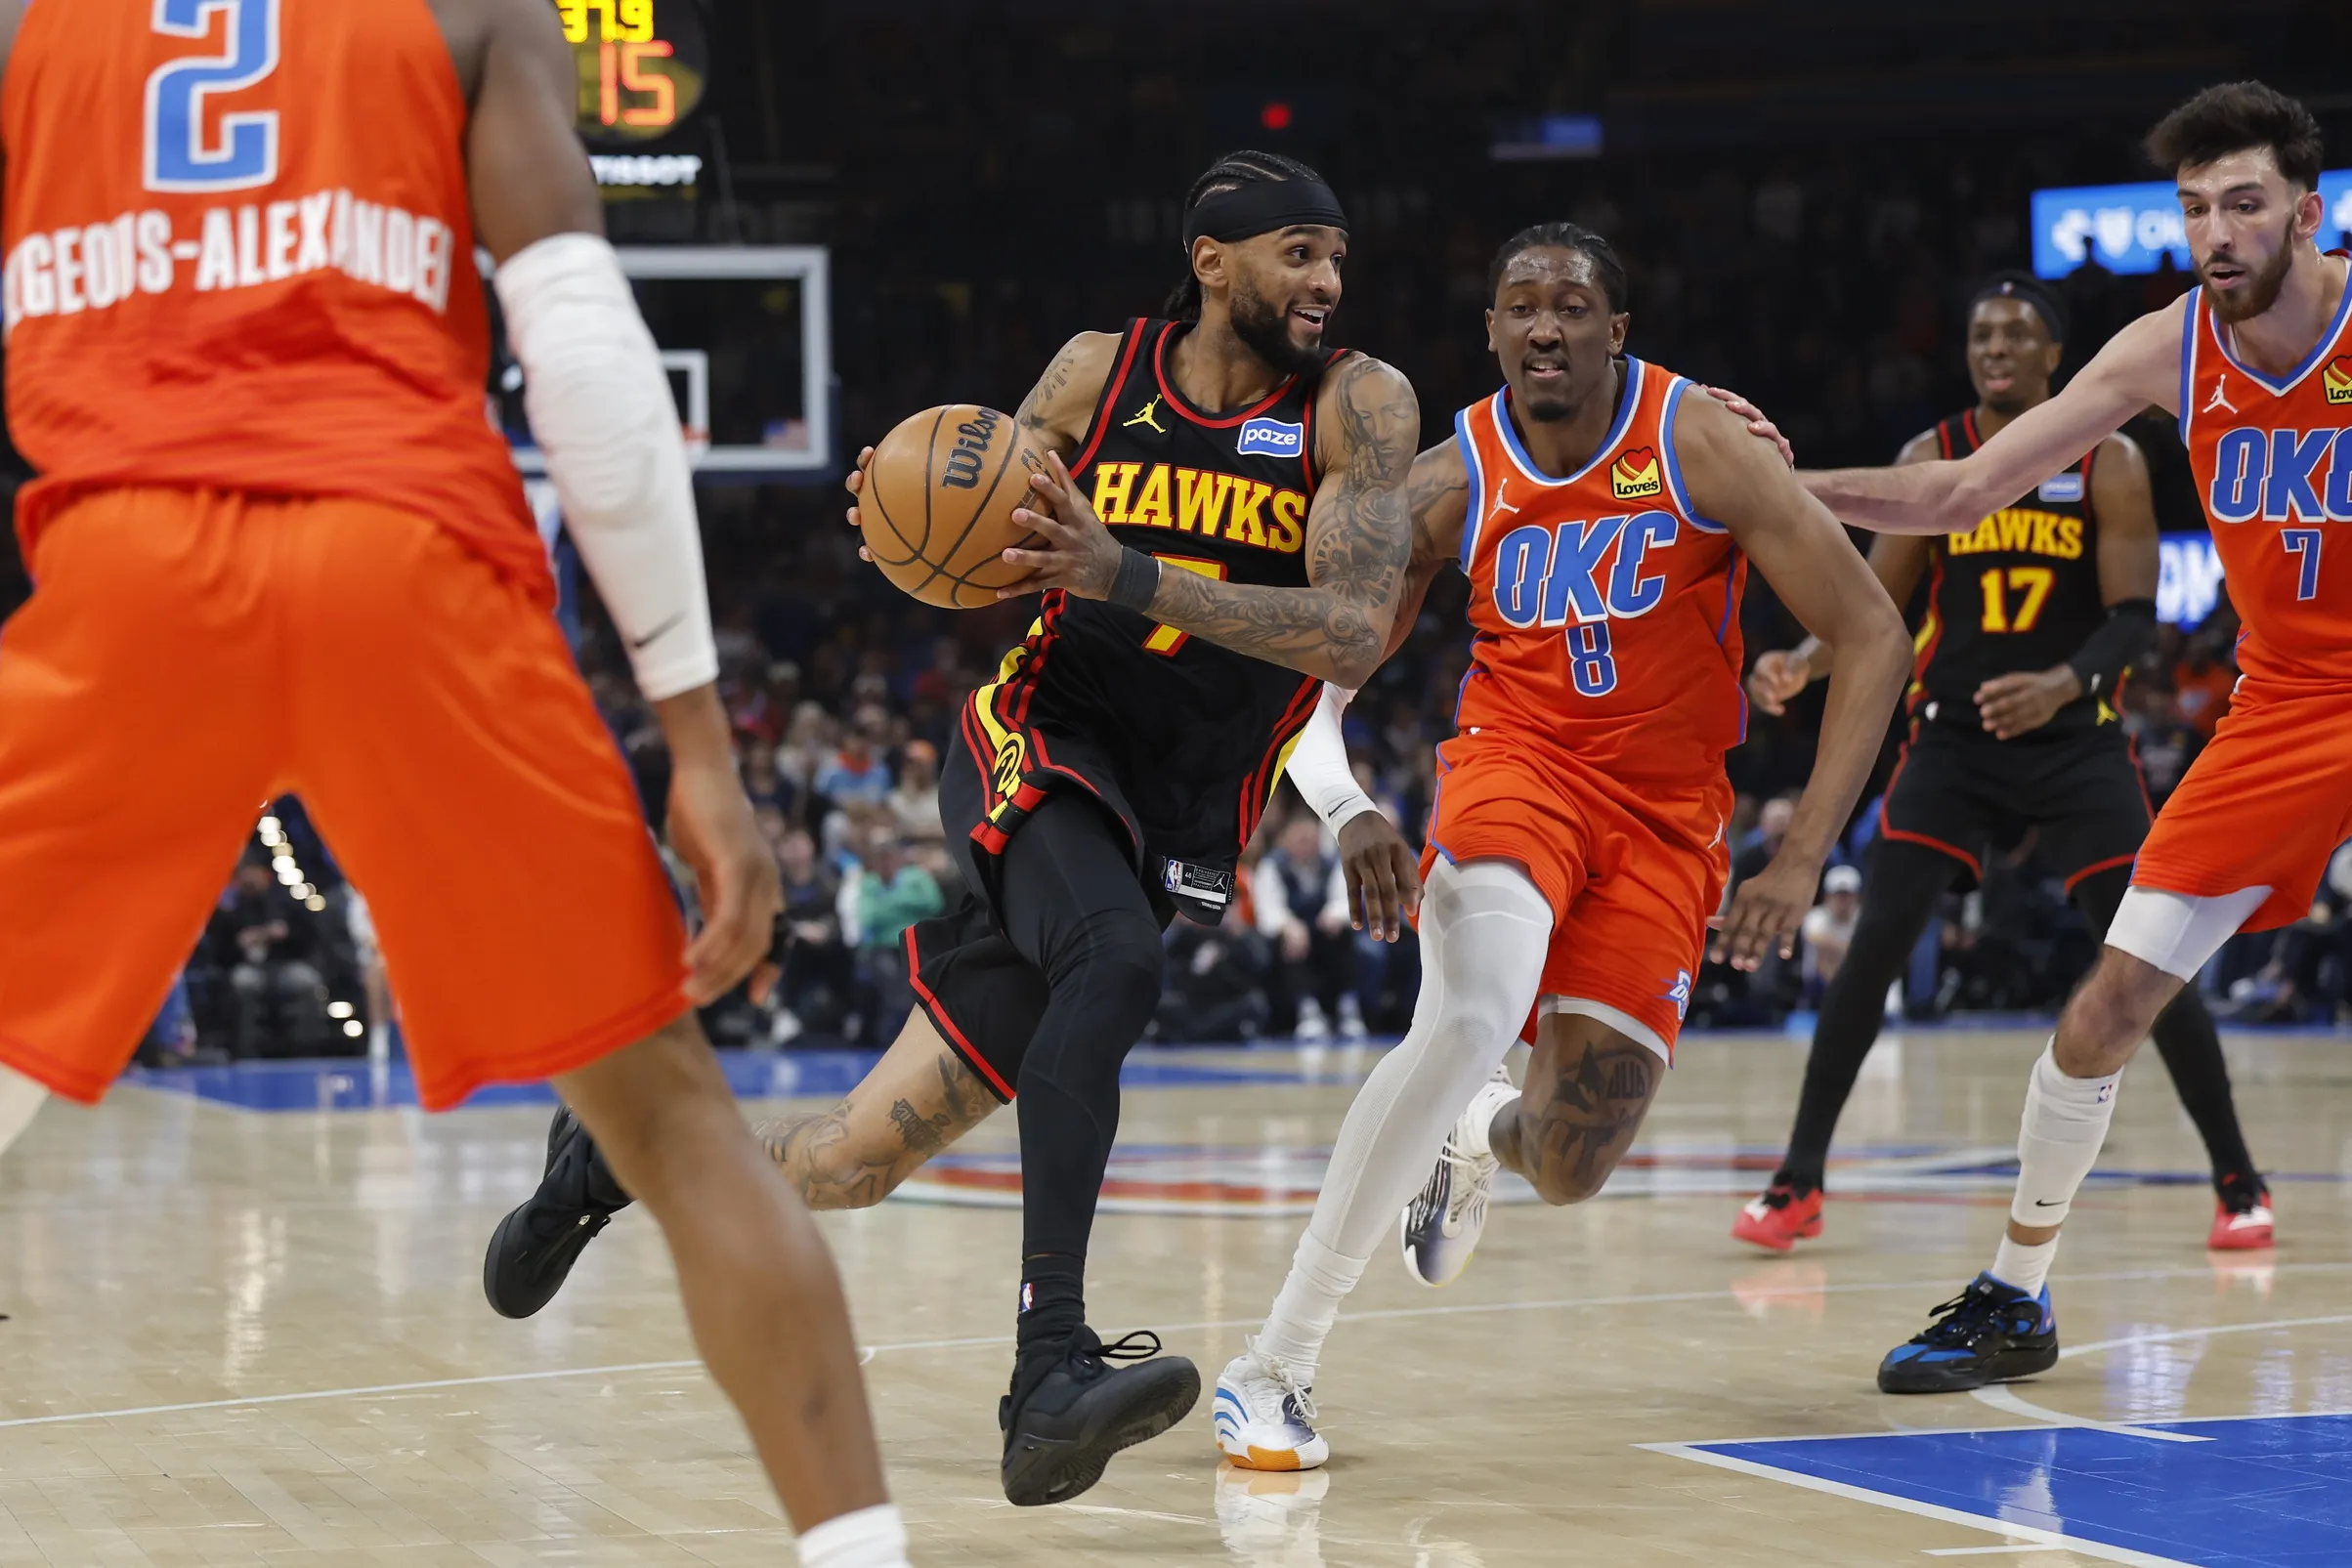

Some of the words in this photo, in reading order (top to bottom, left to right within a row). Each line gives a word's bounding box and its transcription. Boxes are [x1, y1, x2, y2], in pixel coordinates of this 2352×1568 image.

[143, 0, 280, 193] 2
[599, 40, 675, 126] 15
[1244, 428, 1297, 445] paze
[1091, 461, 1306, 554] HAWKS
[1493, 510, 1679, 629] OKC
[1980, 567, 2056, 634] 17
[2280, 529, 2323, 601] 7
[1564, 620, 1618, 698] 8
